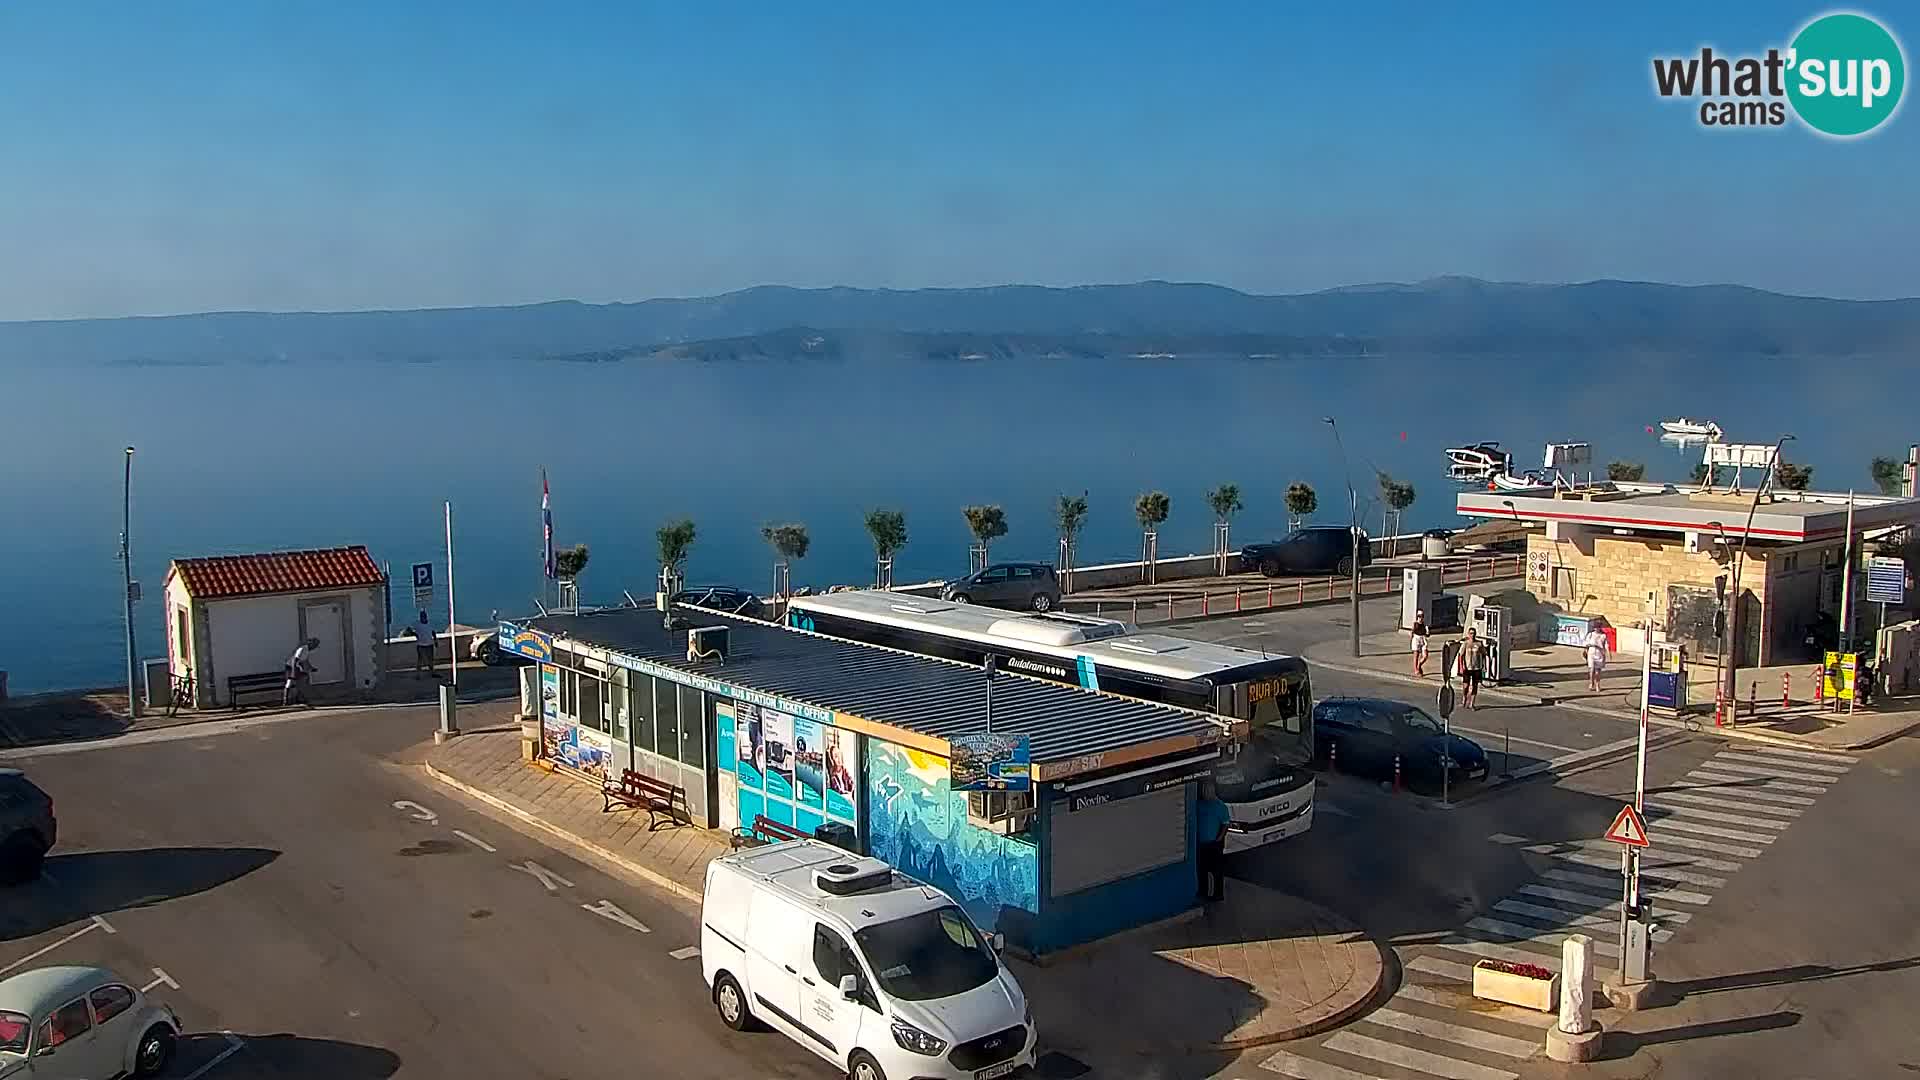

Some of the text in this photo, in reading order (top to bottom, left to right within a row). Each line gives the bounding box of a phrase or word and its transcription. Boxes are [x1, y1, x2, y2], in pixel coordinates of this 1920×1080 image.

[692, 677, 720, 693] POSTAJA
[731, 687, 745, 699] BUS
[745, 690, 777, 708] STATION
[778, 699, 803, 717] TICKET
[804, 706, 830, 722] OFFICE
[1249, 682, 1270, 701] RIVA
[1259, 800, 1290, 817] IVECO
